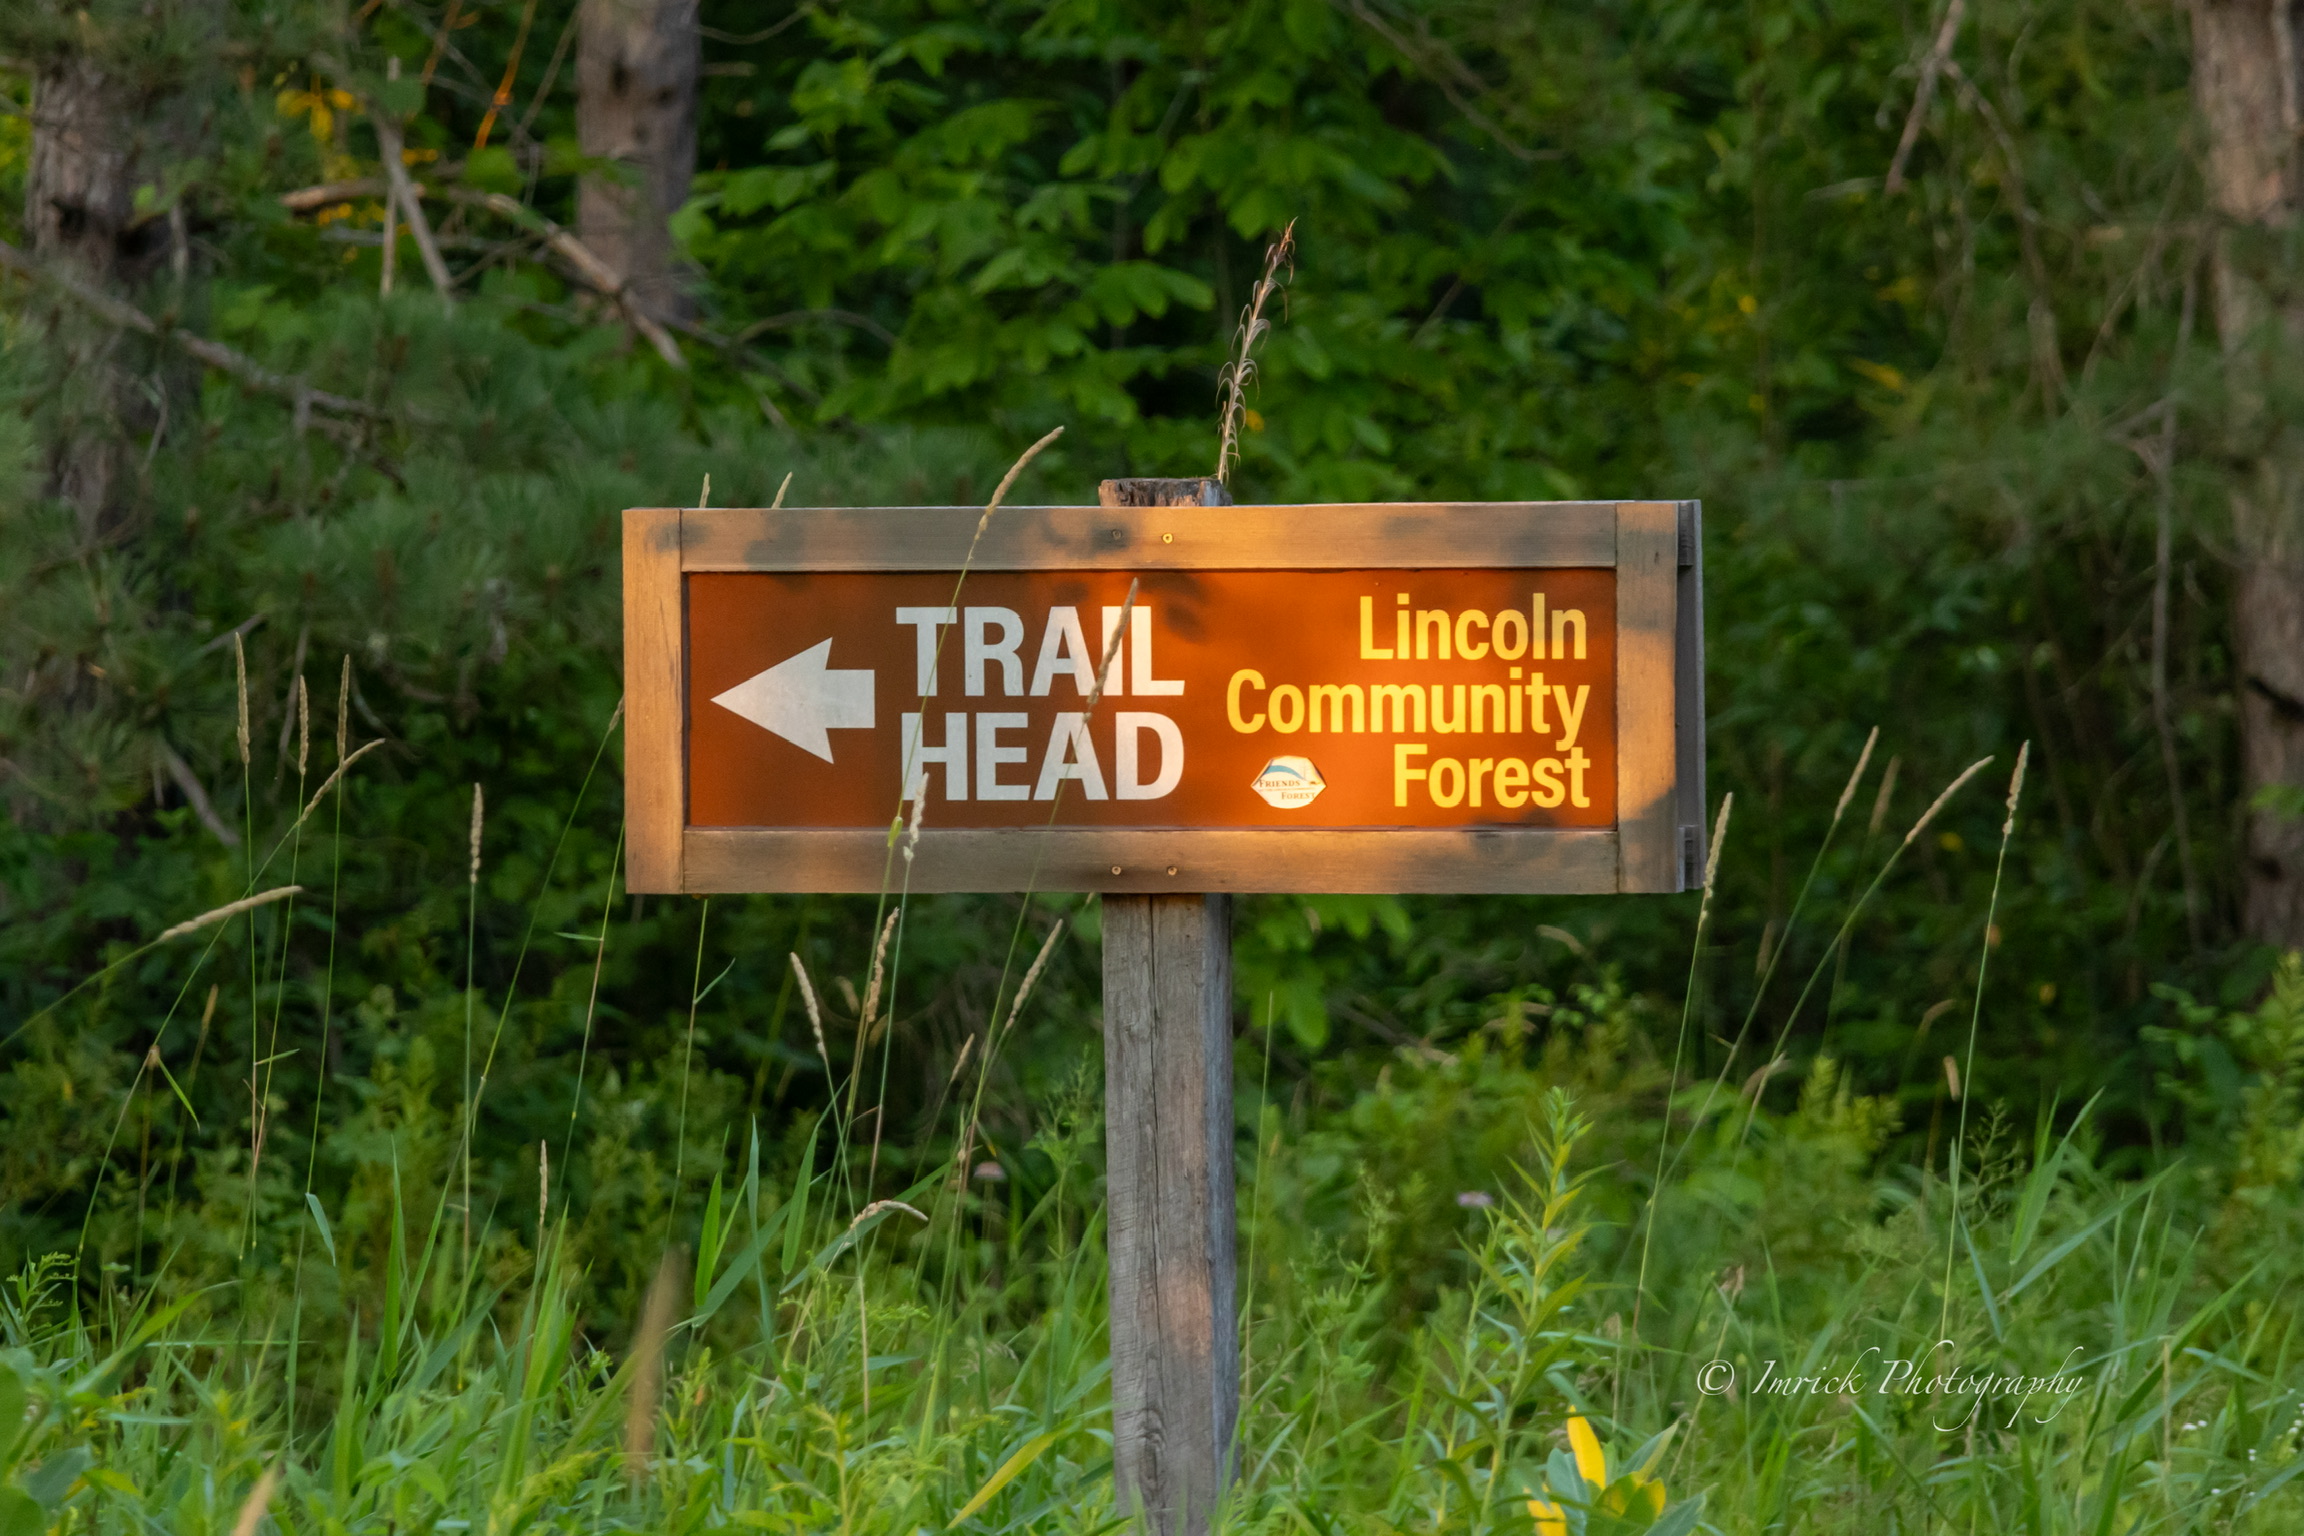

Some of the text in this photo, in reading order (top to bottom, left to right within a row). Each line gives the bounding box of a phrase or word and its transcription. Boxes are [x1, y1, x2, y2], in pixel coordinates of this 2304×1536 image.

[896, 606, 1185, 696] TRAIL
[1360, 593, 1587, 660] Lincoln
[1227, 667, 1590, 751] Community
[901, 712, 1185, 801] HEAD
[1259, 779, 1301, 788] FRIENDS
[1394, 744, 1590, 808] Forest
